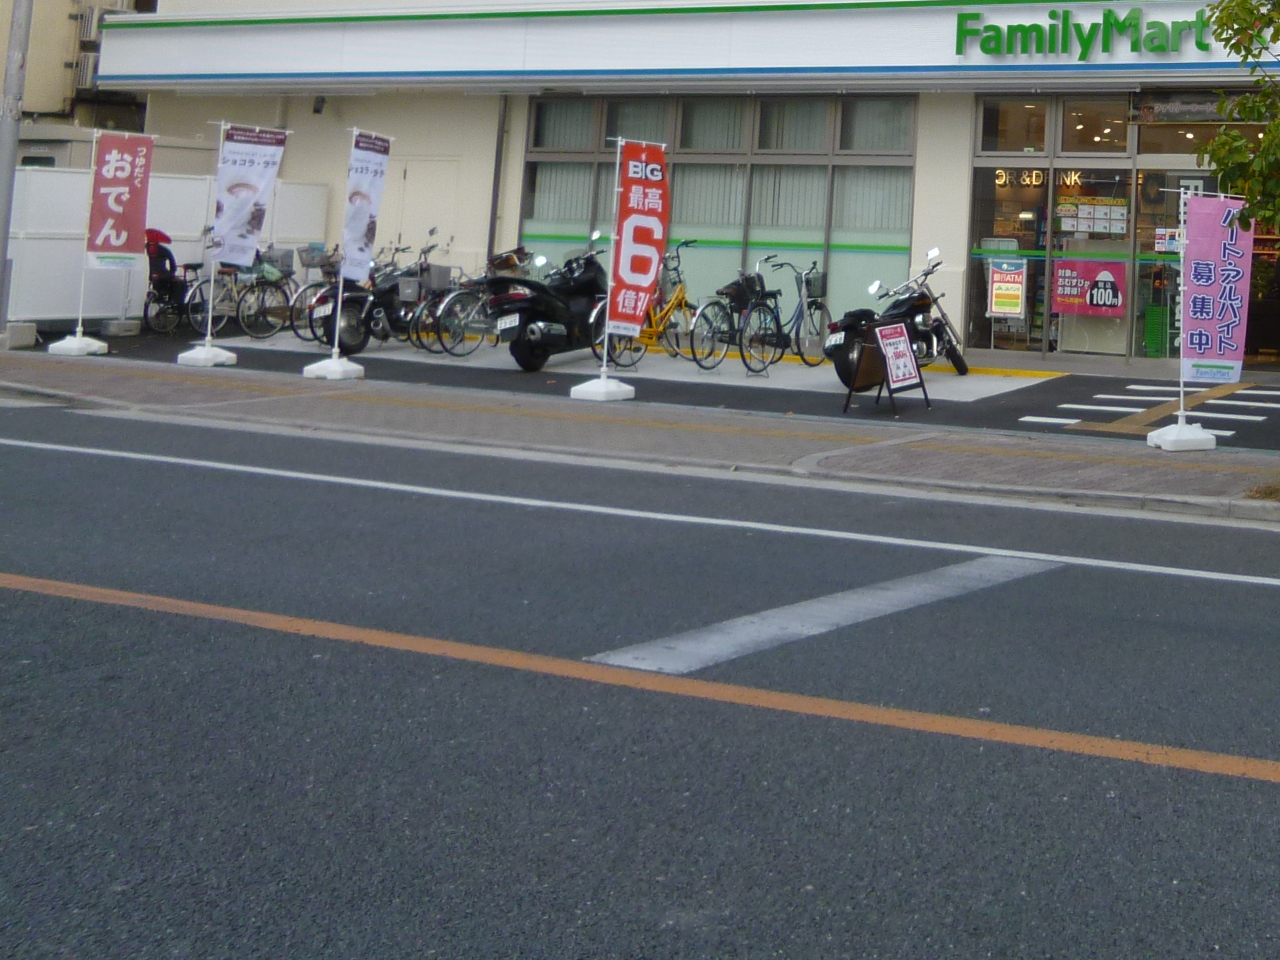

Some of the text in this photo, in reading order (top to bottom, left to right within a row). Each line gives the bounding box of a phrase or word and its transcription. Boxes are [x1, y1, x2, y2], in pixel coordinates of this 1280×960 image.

[955, 7, 1212, 62] FamilyMart
[134, 147, 147, 188] つゆだく
[628, 160, 662, 181] BIG
[95, 149, 133, 246] おでん
[628, 185, 662, 212] 最高
[619, 214, 663, 288] 6
[1092, 288, 1117, 306] 100円
[1188, 260, 1215, 354] 募集中
